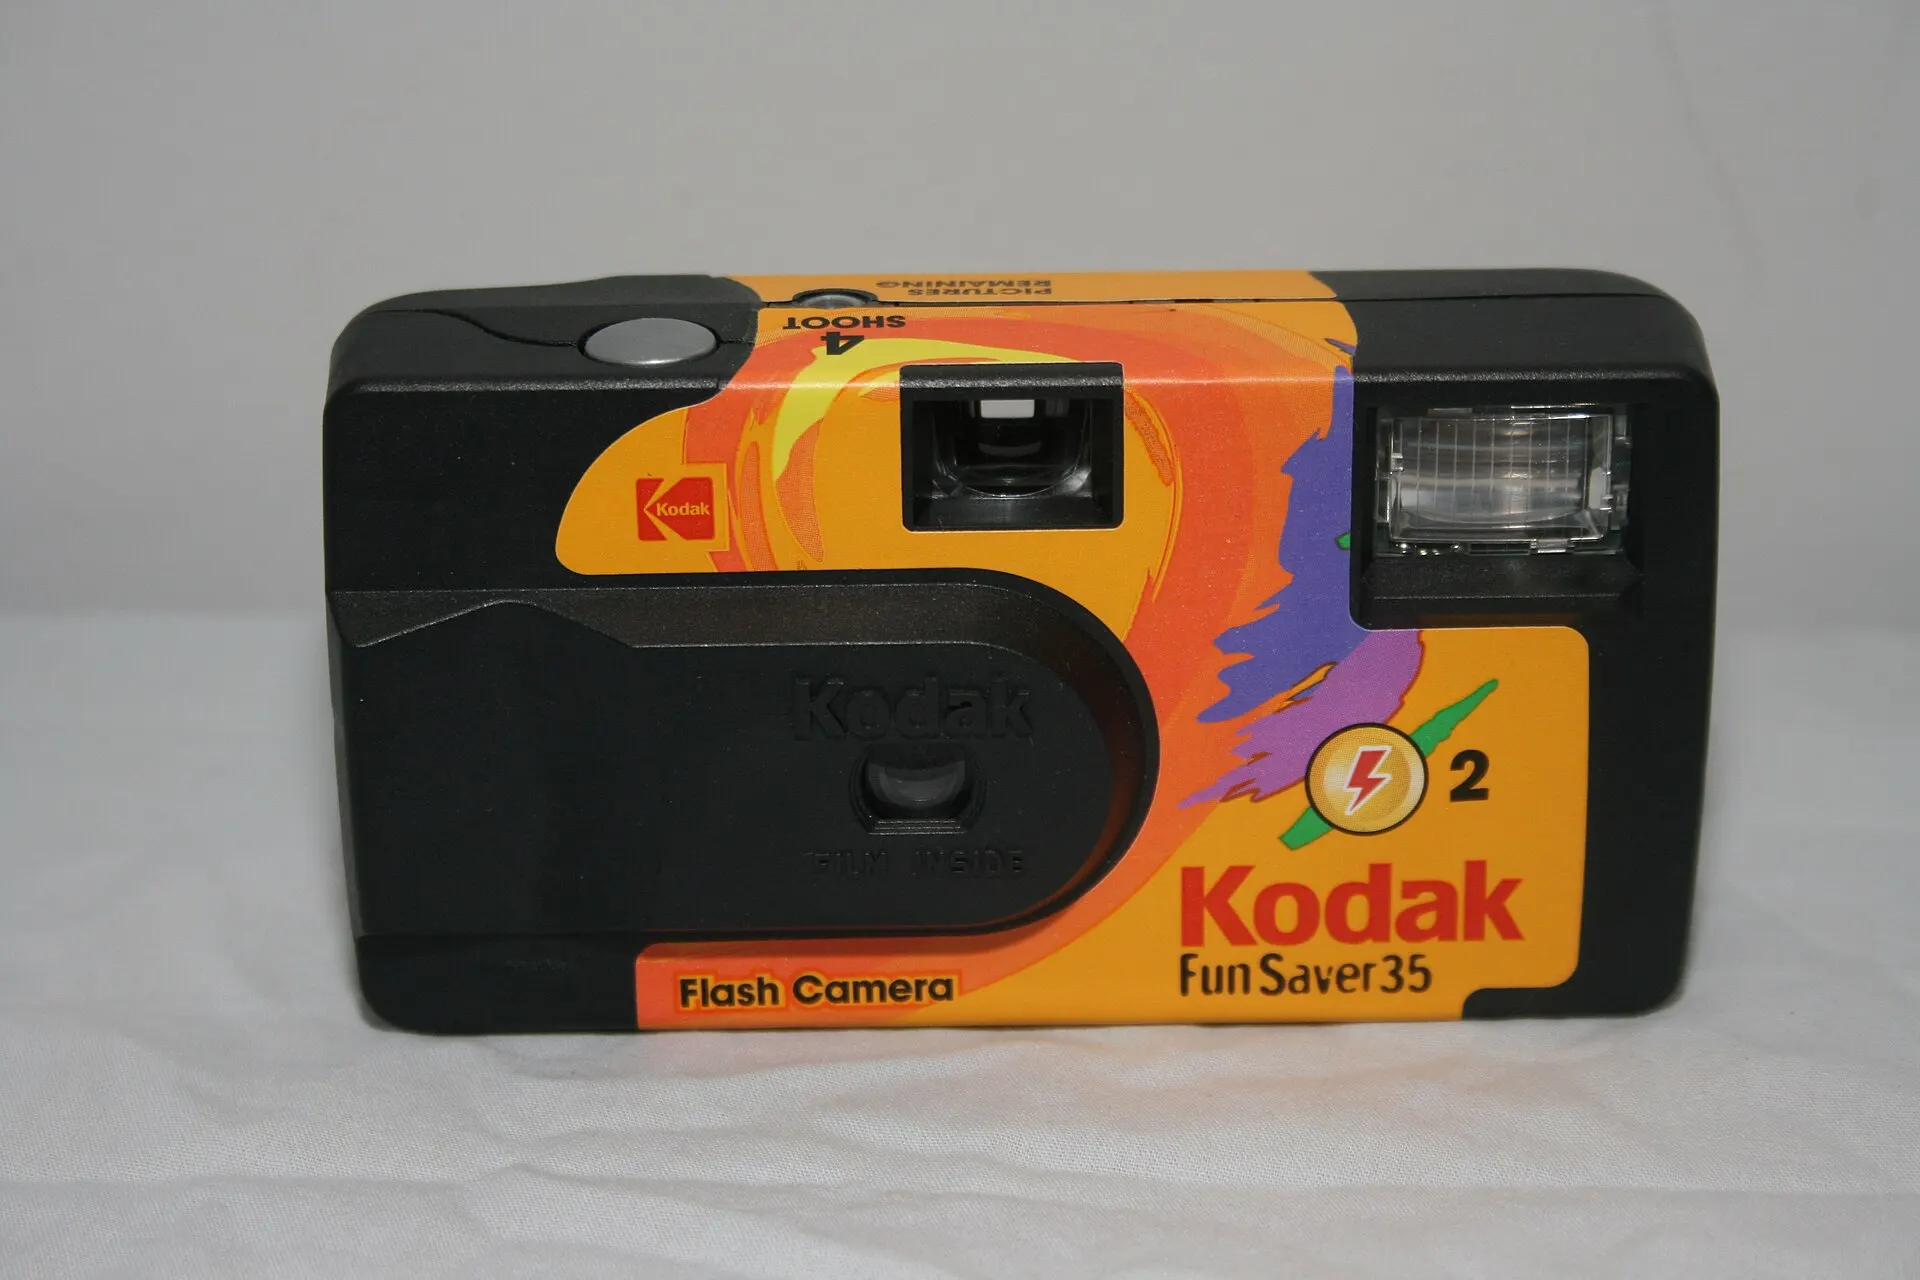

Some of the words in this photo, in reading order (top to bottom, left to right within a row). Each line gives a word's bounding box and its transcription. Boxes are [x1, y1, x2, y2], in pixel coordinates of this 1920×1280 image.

[876, 279, 1052, 289] REMAINING
[908, 287, 1053, 297] PICTURES
[782, 315, 907, 330] SHOOT
[821, 331, 865, 356] 4
[656, 501, 712, 517] Kodak
[793, 674, 1035, 741] Kodak
[1449, 749, 1490, 803] 2
[807, 851, 889, 877] FILM
[911, 850, 1025, 877] INSIDE
[1180, 860, 1525, 948] Kodak
[679, 976, 780, 1009] Flash
[792, 975, 955, 1006] Camera
